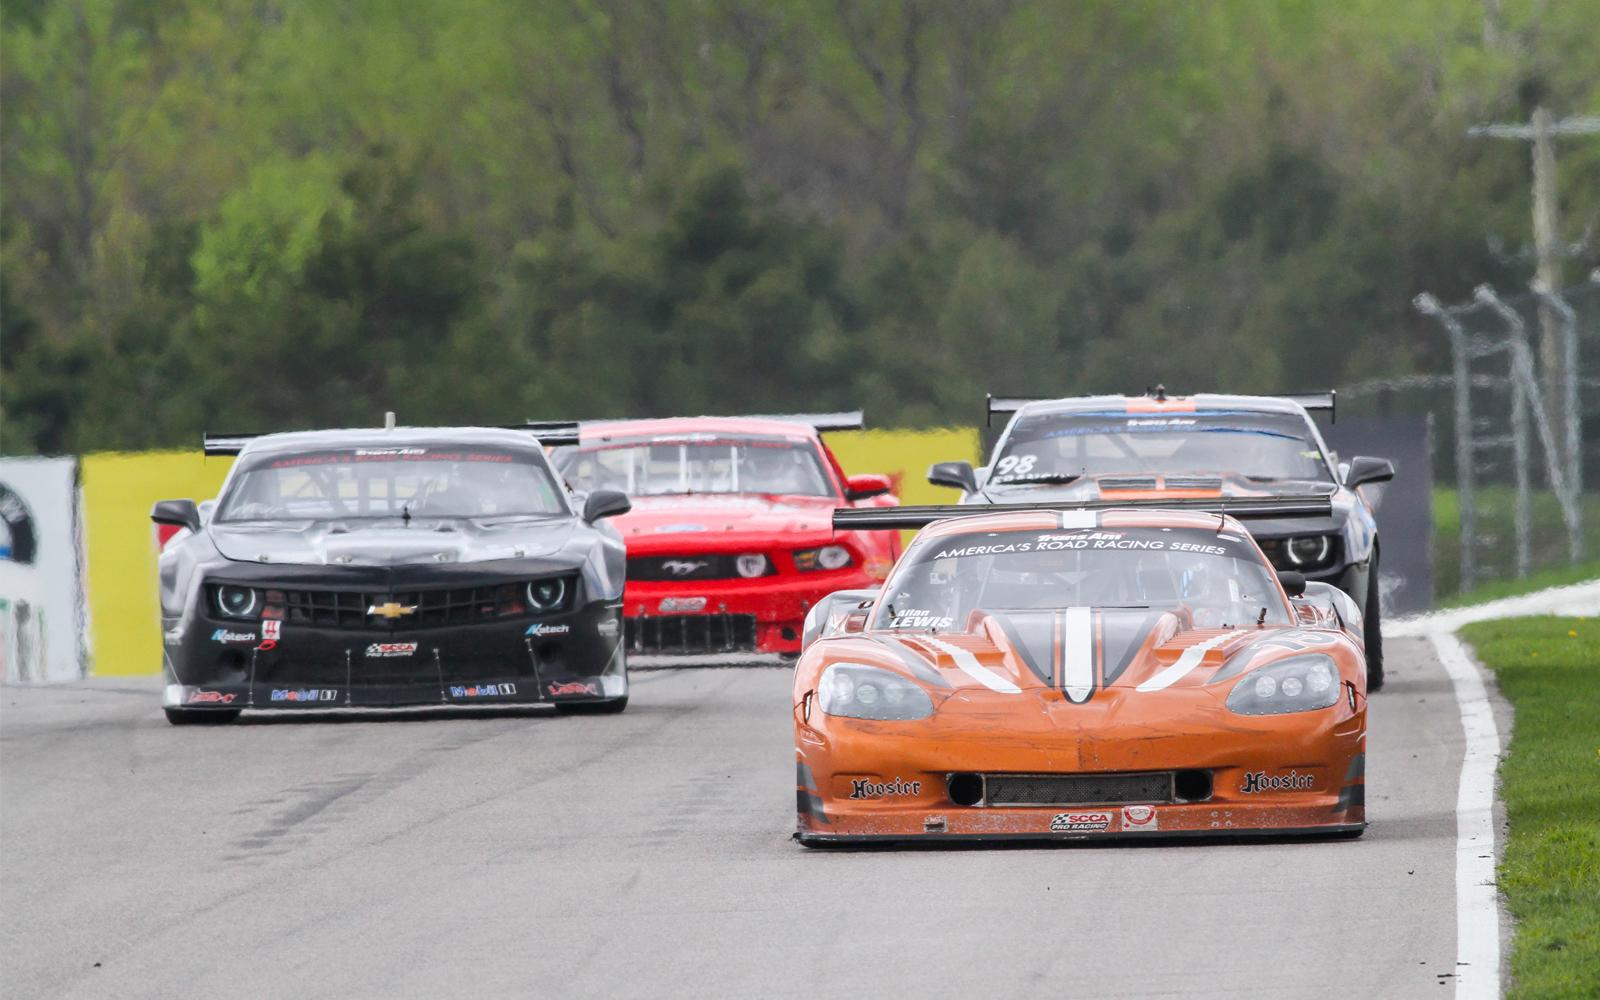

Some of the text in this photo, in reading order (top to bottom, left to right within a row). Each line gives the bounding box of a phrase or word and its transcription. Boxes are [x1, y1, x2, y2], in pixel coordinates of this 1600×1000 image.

[997, 454, 1038, 475] 98
[1038, 532, 1122, 542] Trans Am
[934, 540, 1226, 560] AMERICA'S ROAD RACING SERIES
[889, 616, 953, 628] LEWIS
[271, 689, 319, 701] Mobil
[450, 685, 498, 697] Mobil
[850, 776, 920, 799] Hoosier
[1240, 769, 1314, 794] Hoosier
[1069, 814, 1108, 823] SCCA
[1071, 822, 1107, 830] RACING
